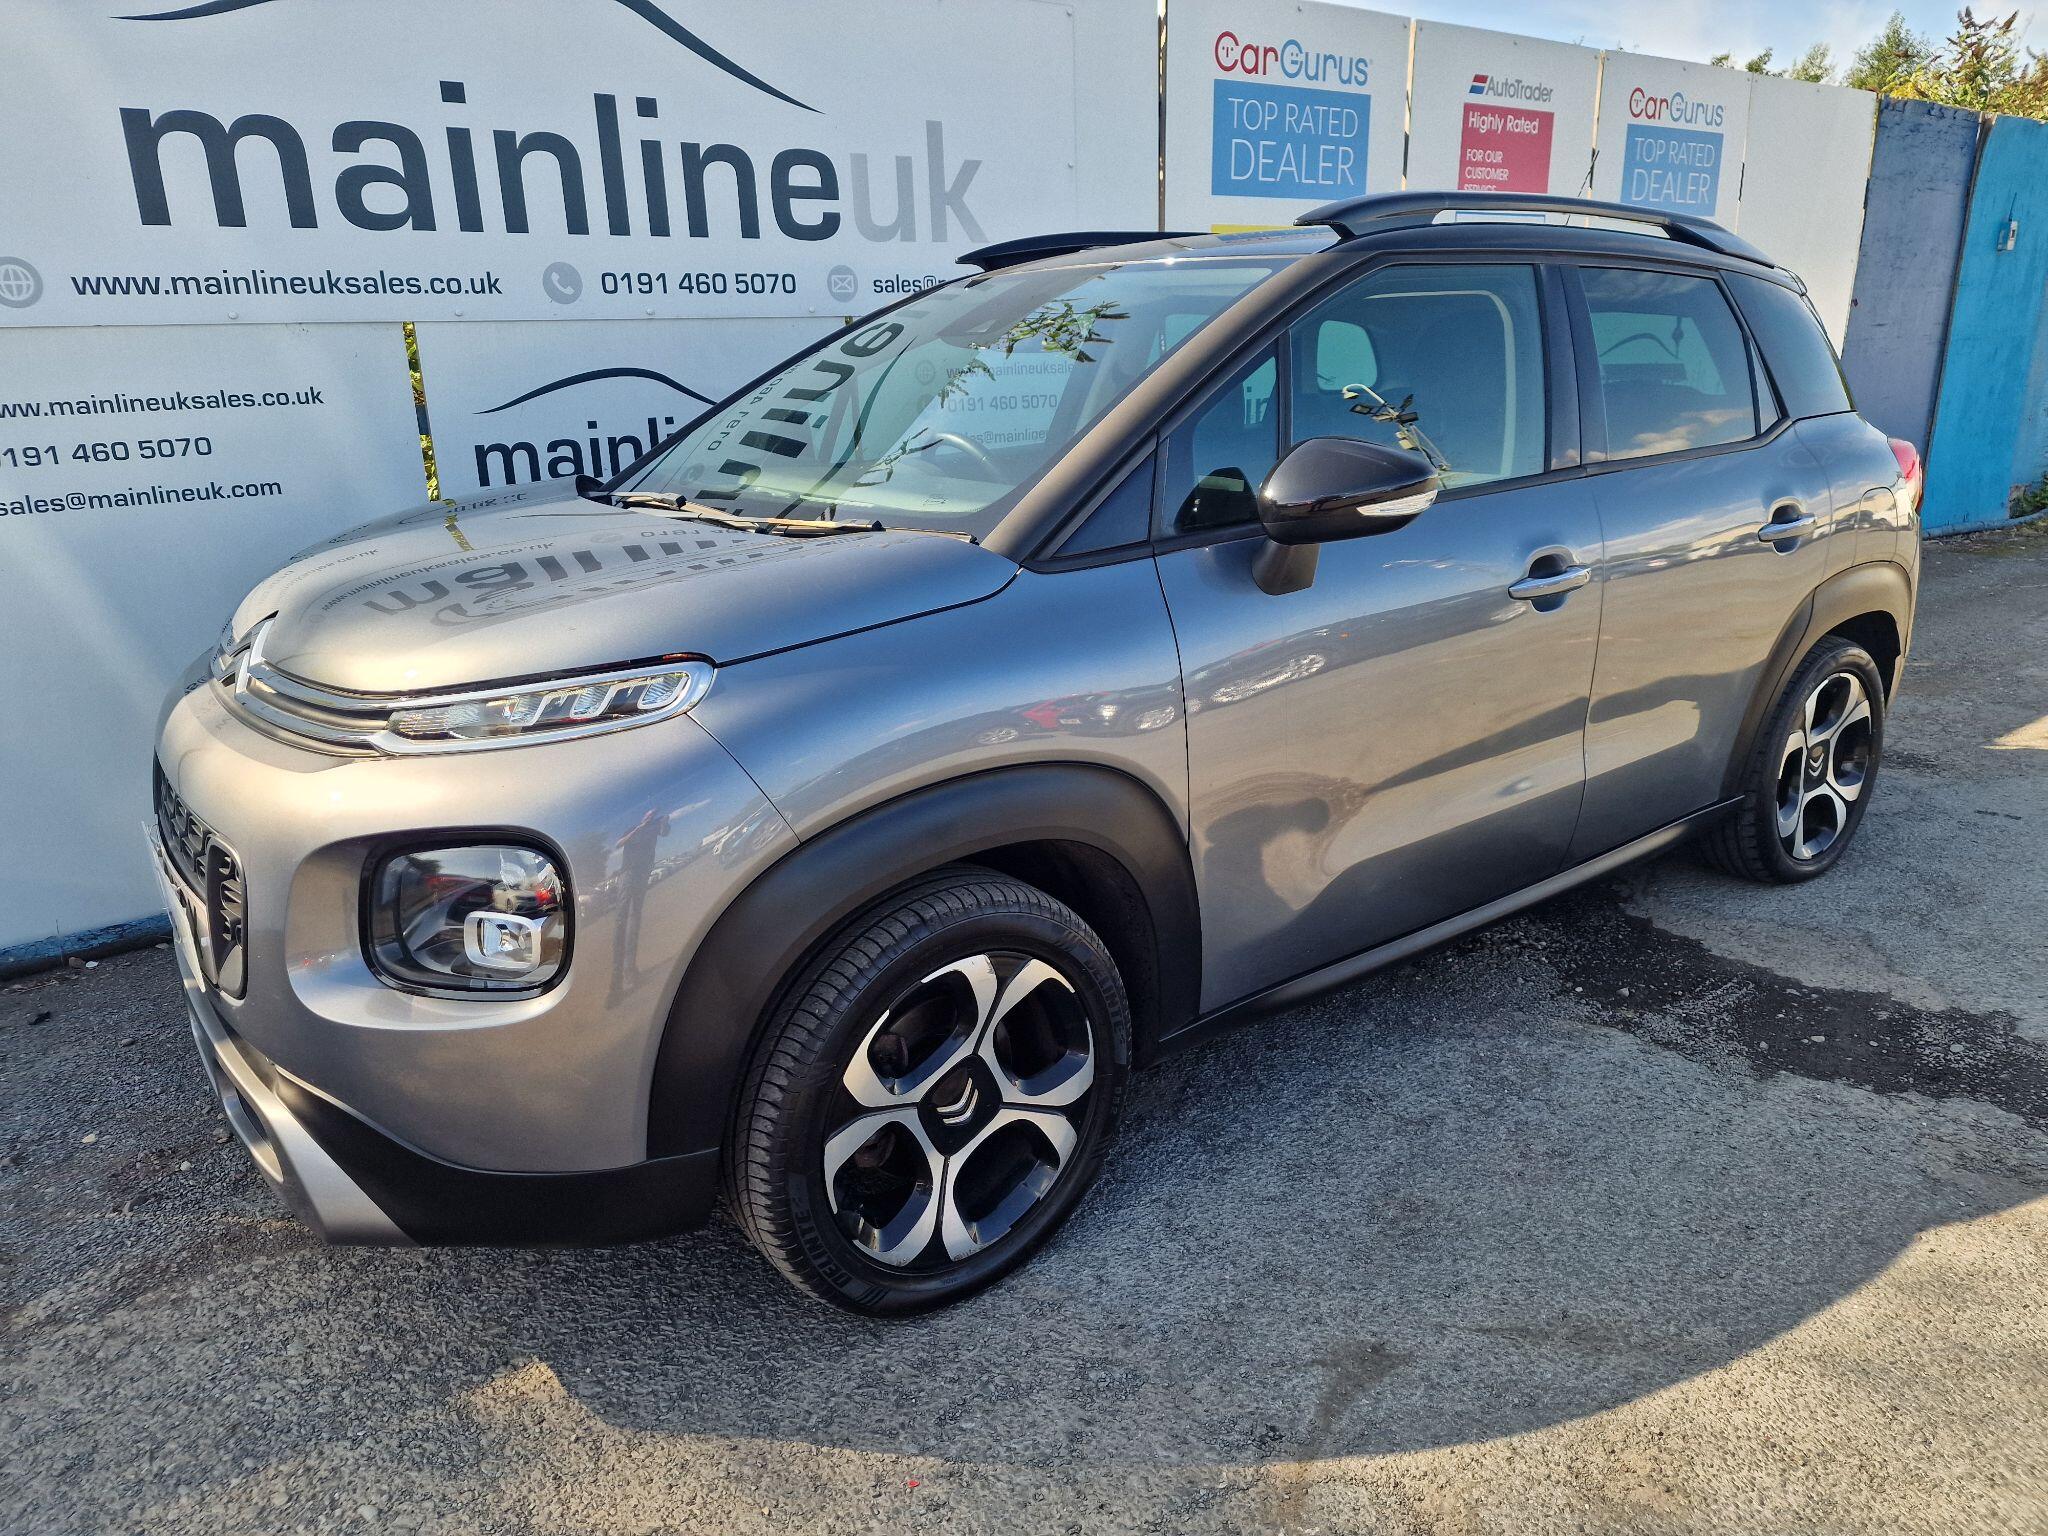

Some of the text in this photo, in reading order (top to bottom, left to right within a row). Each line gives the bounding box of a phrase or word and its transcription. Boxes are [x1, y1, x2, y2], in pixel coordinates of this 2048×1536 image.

[1214, 30, 1369, 87] CarGurus
[1486, 76, 1553, 103] AutoTrader
[1228, 97, 1359, 138] TOP RATED
[1629, 86, 1724, 127] CarGurus
[1468, 111, 1539, 134] Highly Rated
[1230, 138, 1355, 185] DEALER
[1466, 148, 1503, 163] FOR OUR
[1634, 137, 1715, 167] TOP RATED
[1465, 166, 1510, 181] CUSTOMER
[1631, 168, 1711, 204] DEALER
[71, 269, 503, 296] www.mainlineuksales.co.uk
[601, 272, 797, 295] 0191 460 5070
[873, 273, 947, 293] sales@
[948, 394, 1058, 412] 0191 460 5070
[0, 436, 212, 467] 191 460 5070
[0, 481, 282, 517] sales@mainlineuk.com
